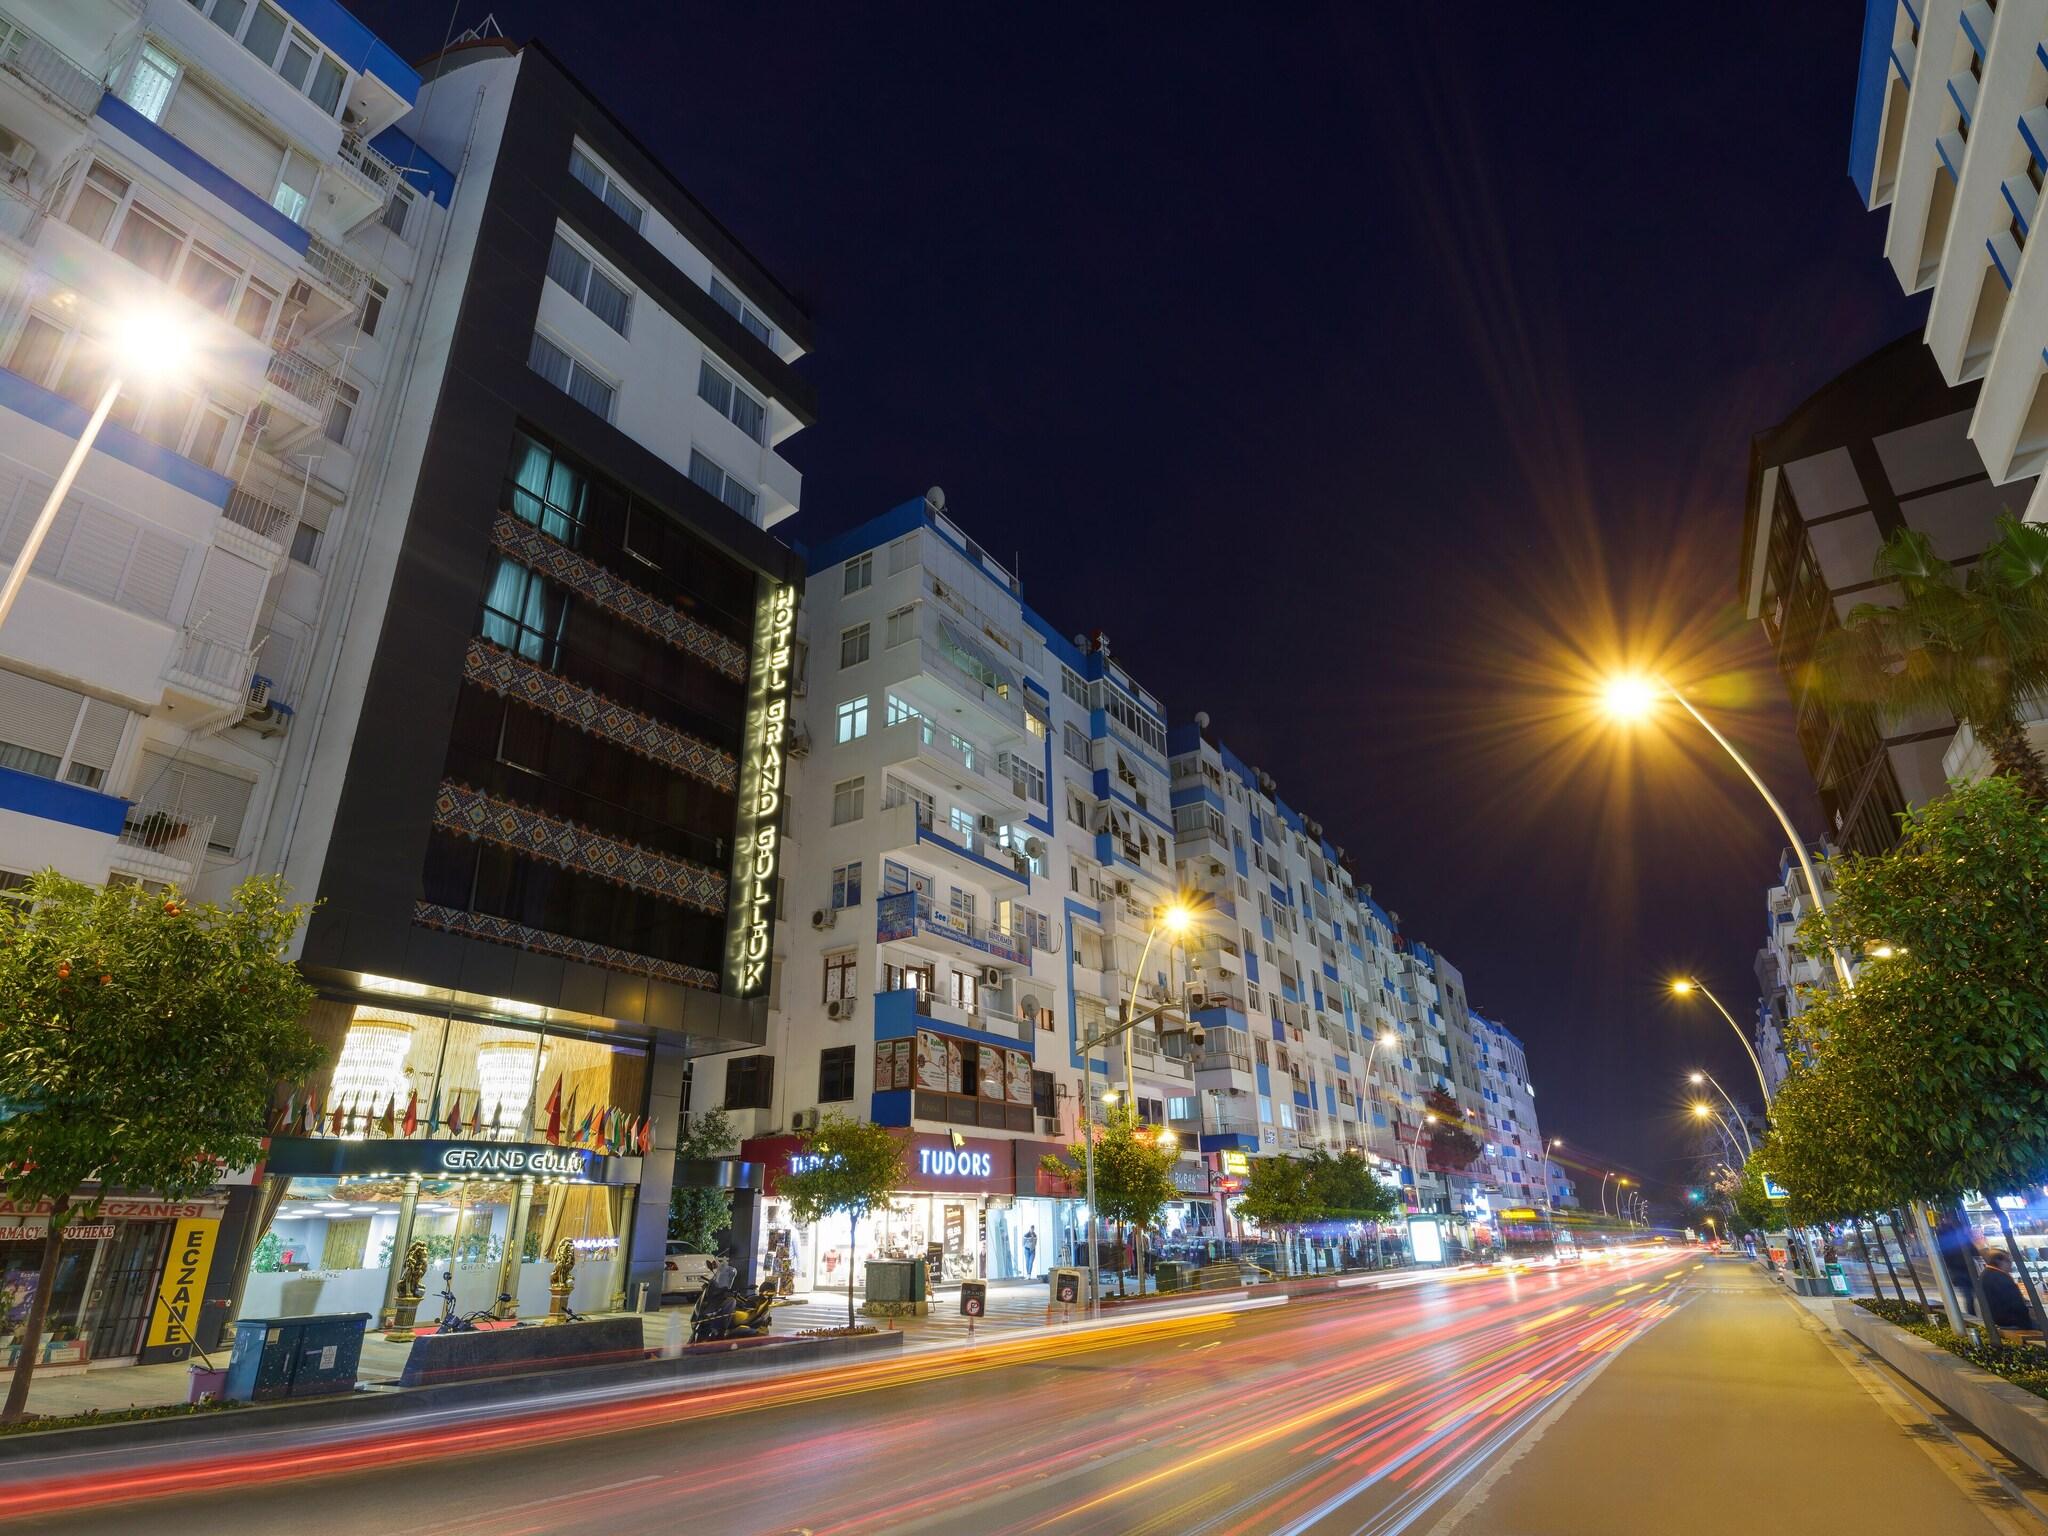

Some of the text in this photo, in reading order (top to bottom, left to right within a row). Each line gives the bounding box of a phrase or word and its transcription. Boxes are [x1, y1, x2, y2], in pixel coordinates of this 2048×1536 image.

[744, 584, 795, 991] HOTEL GRAND GÜLLÜK
[444, 1150, 527, 1169] GRAND
[920, 1149, 991, 1177] TUDORS
[63, 1226, 114, 1239] POTHEKE
[165, 1230, 204, 1343] ECZANE
